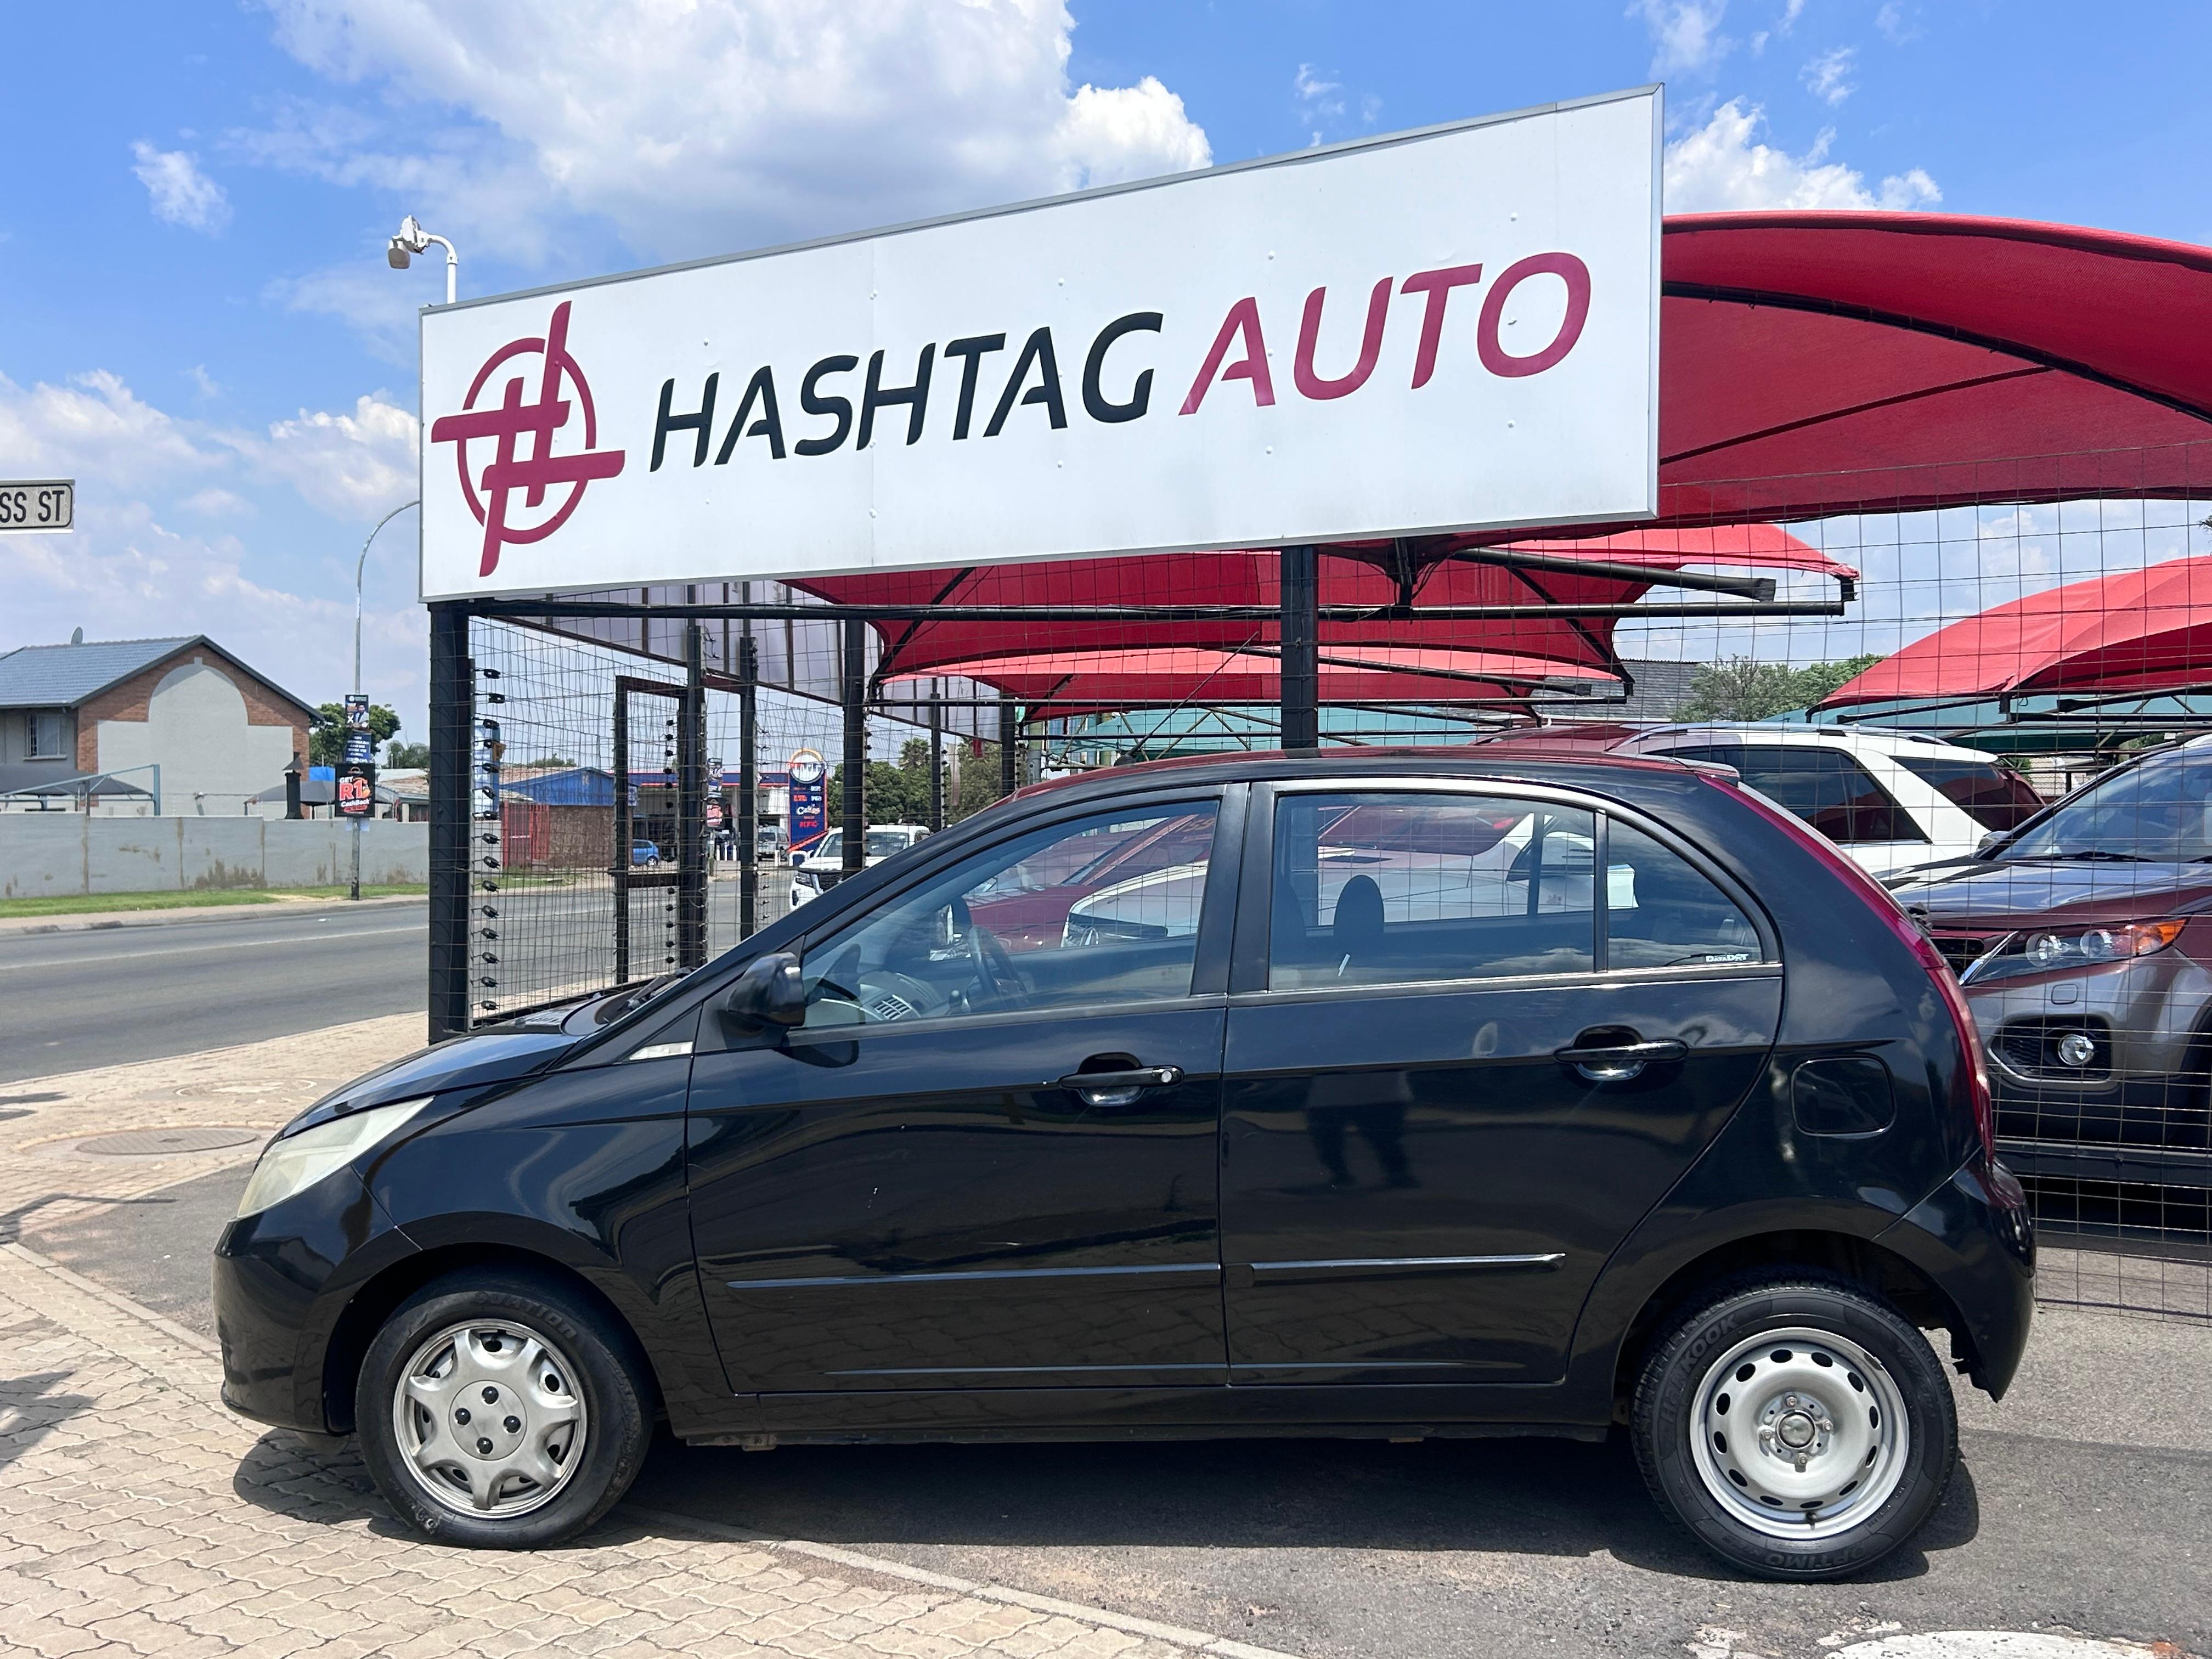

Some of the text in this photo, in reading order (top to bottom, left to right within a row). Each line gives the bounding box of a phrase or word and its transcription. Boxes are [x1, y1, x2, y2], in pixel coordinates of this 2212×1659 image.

[650, 252, 1591, 472] HASHTAG AUTO
[38, 490, 65, 522] ST
